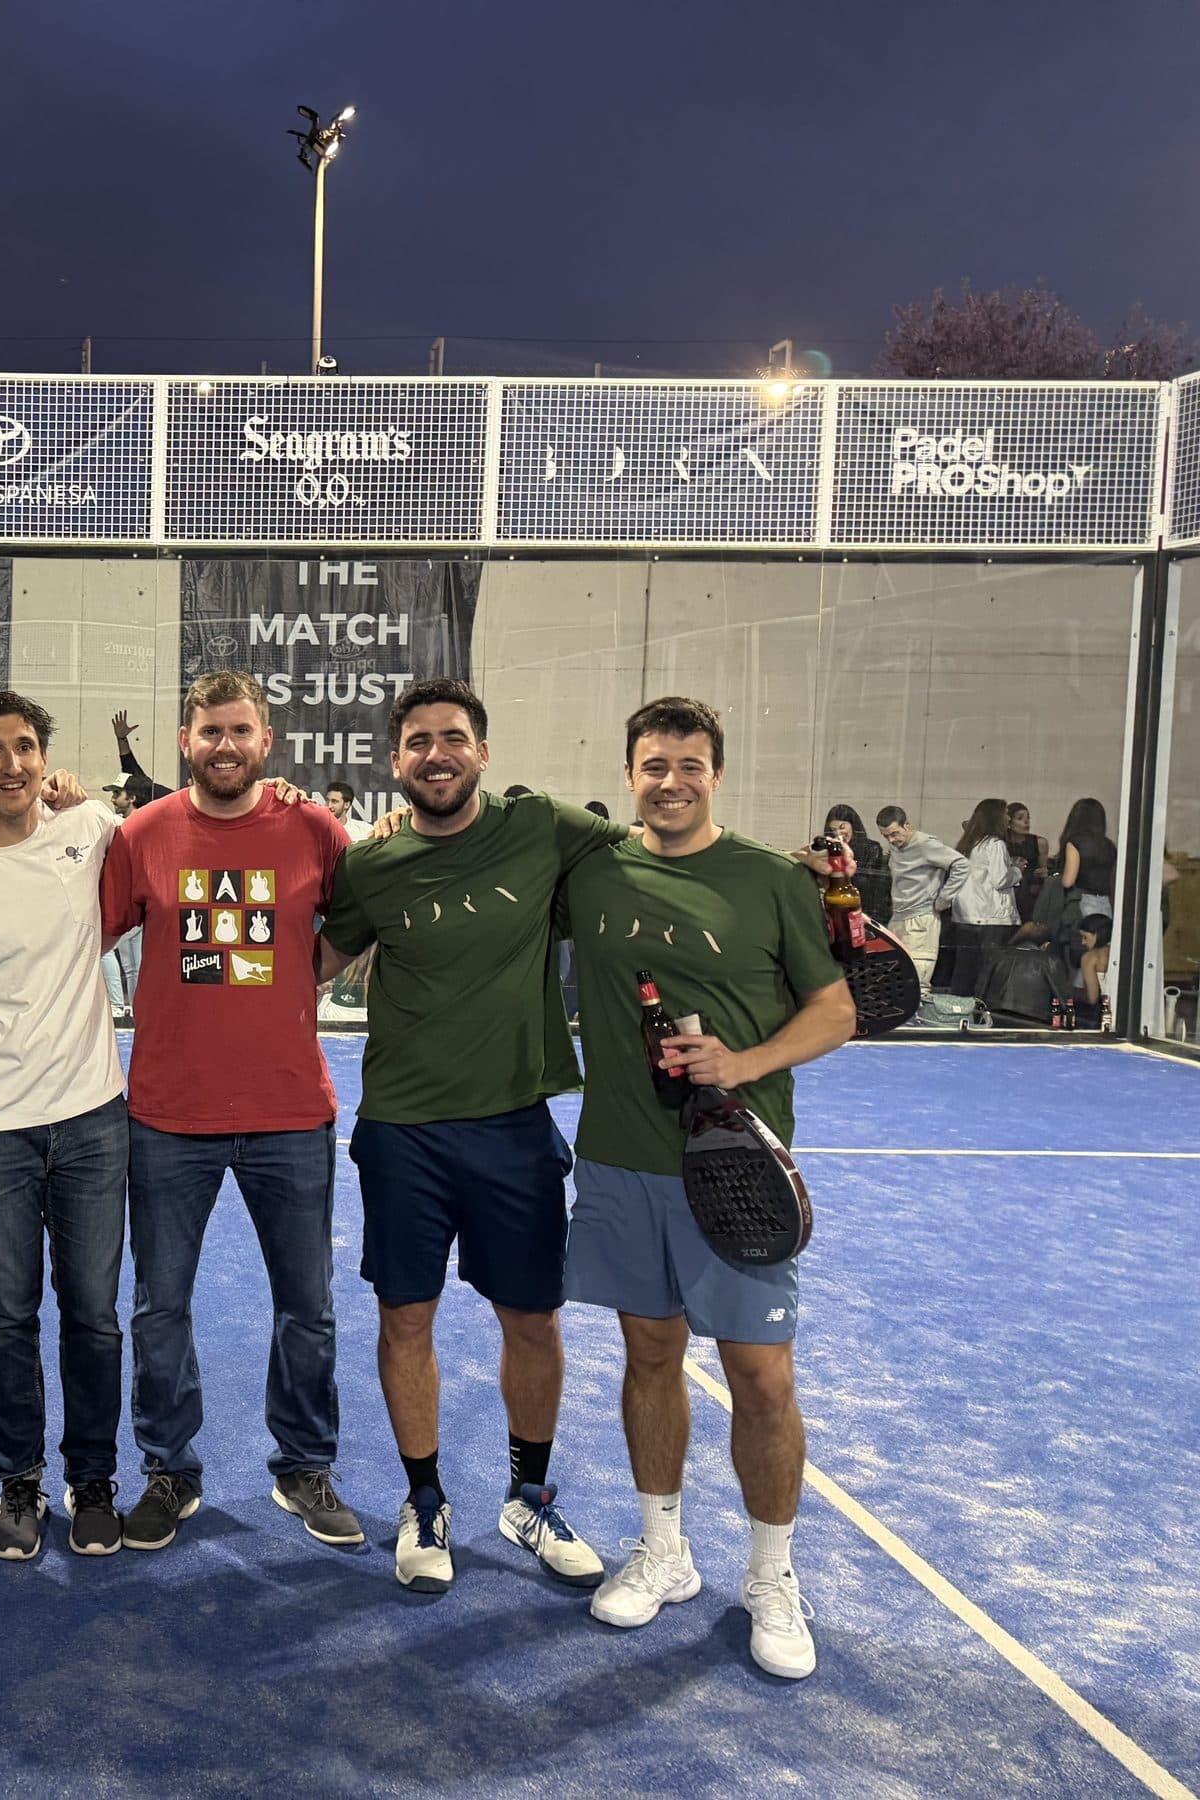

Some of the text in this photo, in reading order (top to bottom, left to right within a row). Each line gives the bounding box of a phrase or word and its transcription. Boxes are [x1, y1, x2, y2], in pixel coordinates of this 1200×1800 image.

[239, 416, 412, 470] Seagram's
[893, 428, 995, 461] Padel
[891, 462, 1071, 505] PROShop
[249, 613, 409, 646] MATCH
[301, 673, 415, 706] JUST
[286, 732, 374, 765] THE
[182, 953, 222, 979] Gibson
